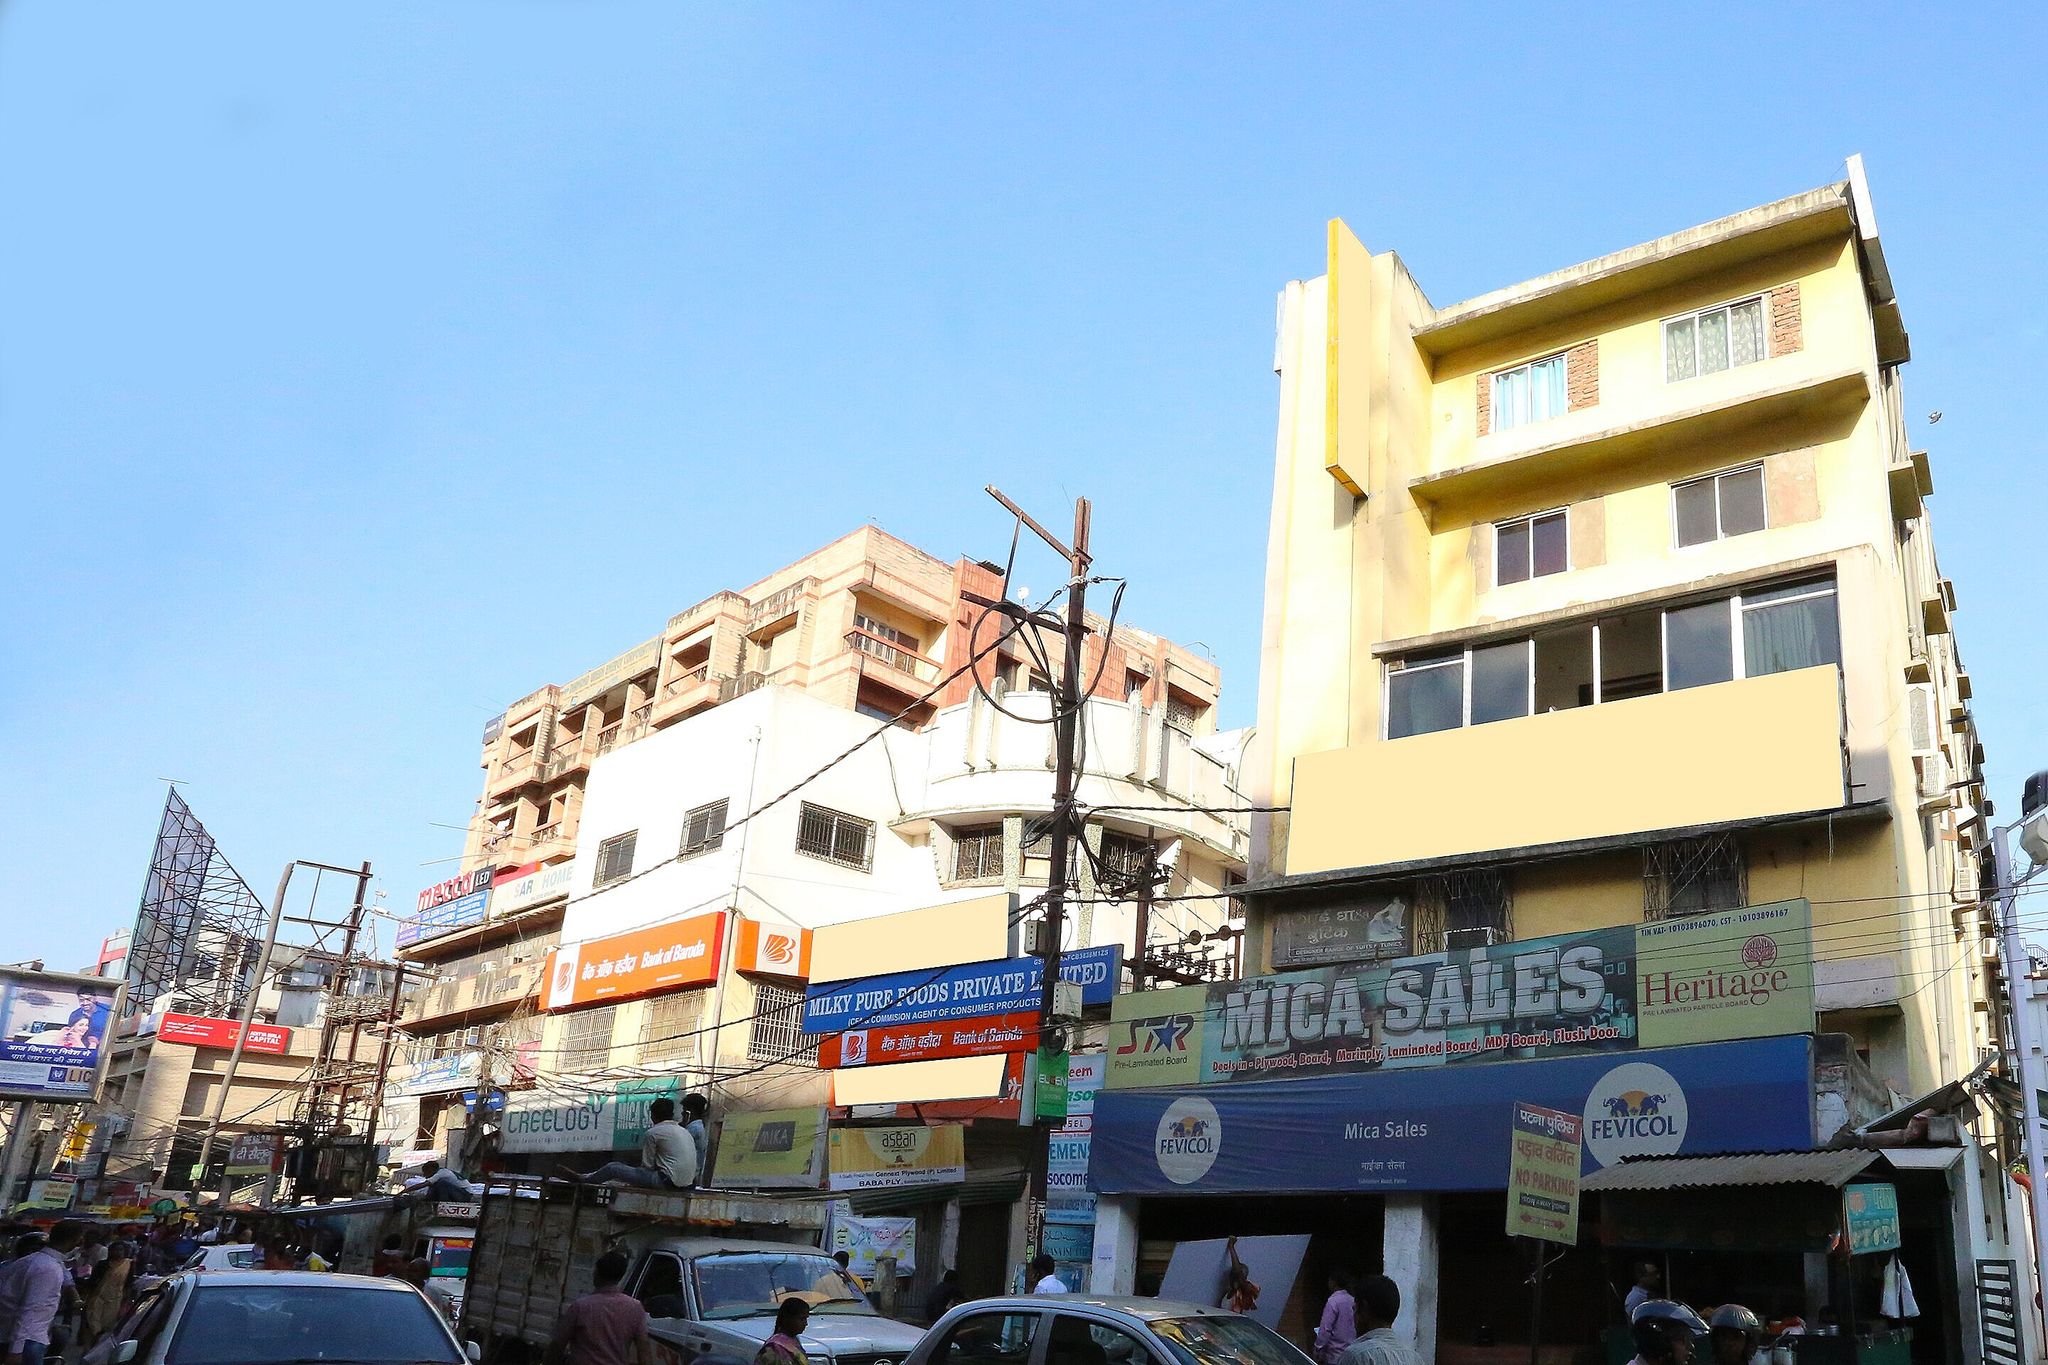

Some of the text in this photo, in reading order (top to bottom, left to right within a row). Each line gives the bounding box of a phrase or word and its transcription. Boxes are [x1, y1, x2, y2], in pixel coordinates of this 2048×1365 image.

[475, 871, 490, 888] LED
[1721, 917, 1731, 925] CST
[1739, 909, 1789, 922] 10103896167
[641, 939, 705, 968] Bank of Baroda
[809, 994, 853, 1017] MILKY
[855, 989, 893, 1012] PURE
[897, 982, 949, 1007] FOODS
[953, 972, 1025, 1001] PRIVATE
[1643, 970, 1788, 1006] Heritage
[1222, 945, 1606, 1050] MICA SALES
[912, 1009, 937, 1019] AGENT
[938, 1006, 949, 1016] OF
[951, 1003, 994, 1016] CONSUMER
[996, 997, 1041, 1010] PRODUCTS
[1656, 1006, 1691, 1015] LAMINATED
[1693, 1003, 1723, 1012] PARTICLE
[1725, 1000, 1749, 1008] BOARD
[249, 1036, 280, 1045] CAPITAL
[953, 1026, 1023, 1045] Bank of Baroda
[1212, 1060, 1236, 1073] Deals
[1299, 1051, 1332, 1065] Board,
[1388, 1041, 1442, 1058] Laminated
[1446, 1037, 1482, 1054] Board,
[1484, 1035, 1509, 1050] MDF
[1511, 1032, 1552, 1048] Board,
[1554, 1028, 1585, 1043] Flush
[1590, 1026, 1620, 1040] Door
[1069, 1066, 1092, 1078] eem
[1114, 1056, 1188, 1070] Pre-Laminated Board
[69, 1070, 91, 1083] LIC
[1345, 1120, 1427, 1139] Mica Sales
[1520, 1109, 1575, 1135] पटना पुलिस
[1592, 1116, 1678, 1139] FEVICOL
[882, 1132, 916, 1147] asean
[1160, 1137, 1213, 1154] FEVICOL
[1050, 1143, 1090, 1160] EMEN
[1516, 1168, 1575, 1196] NO PARKING
[447, 1206, 471, 1216] जय
